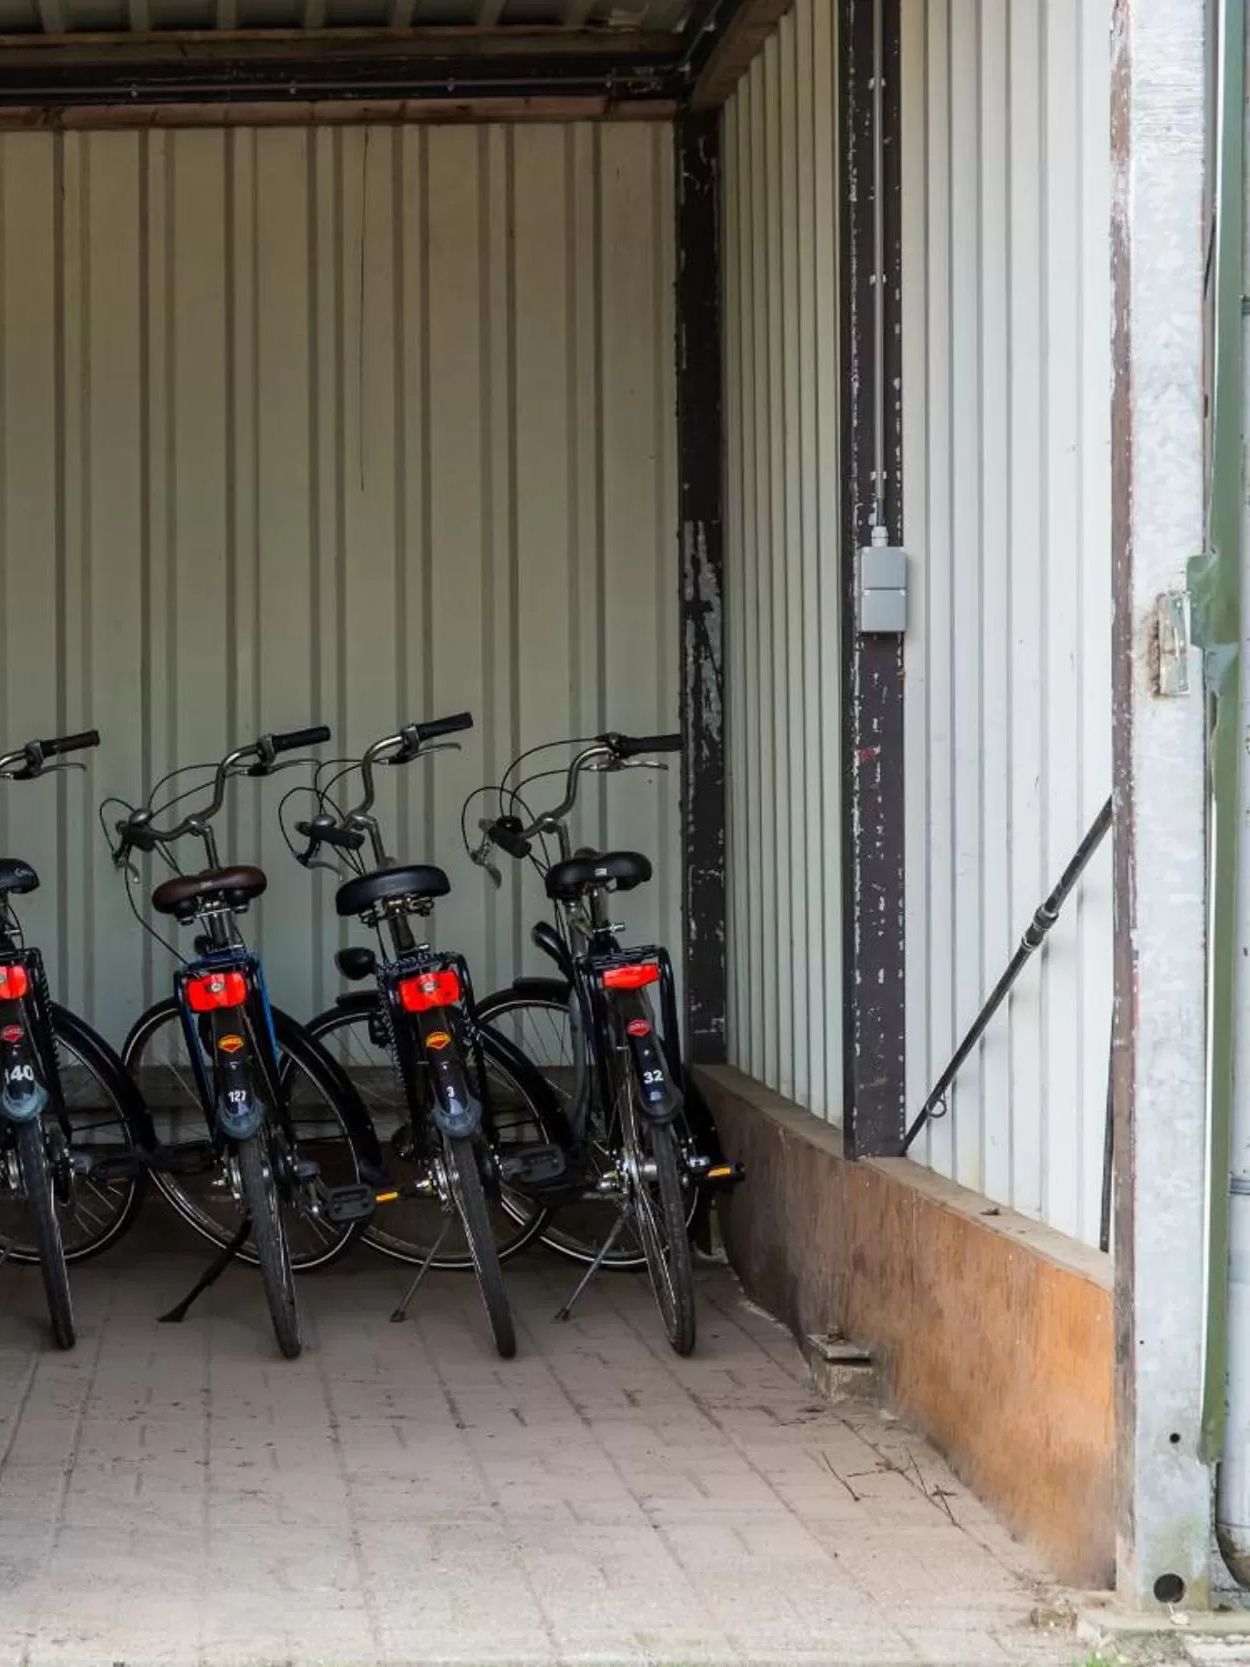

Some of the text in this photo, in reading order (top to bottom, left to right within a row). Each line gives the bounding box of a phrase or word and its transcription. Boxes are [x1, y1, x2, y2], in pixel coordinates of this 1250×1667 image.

[642, 1069, 664, 1084] 32
[228, 1090, 246, 1102] 127
[445, 1086, 455, 1098] 3
